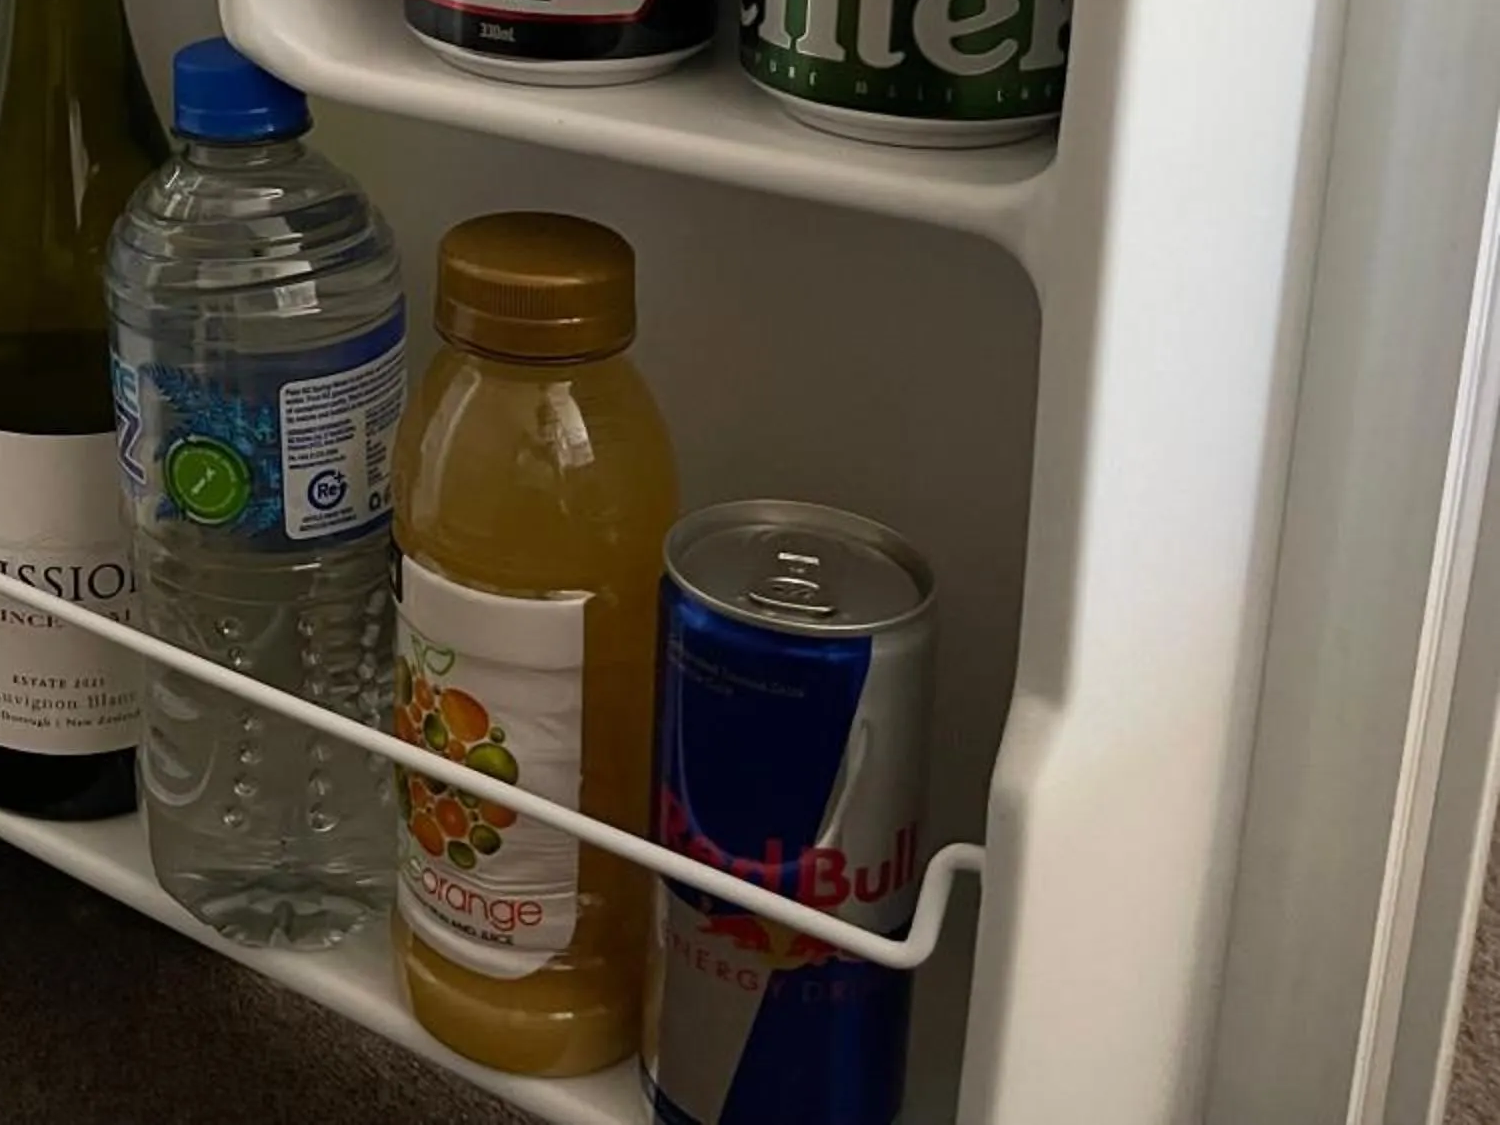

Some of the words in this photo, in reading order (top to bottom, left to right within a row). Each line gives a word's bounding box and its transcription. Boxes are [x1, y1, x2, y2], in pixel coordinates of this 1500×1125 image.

[317, 482, 338, 498] Re
[12, 674, 67, 689] ESTATE
[800, 824, 918, 910] Bull
[420, 867, 544, 933] orange
